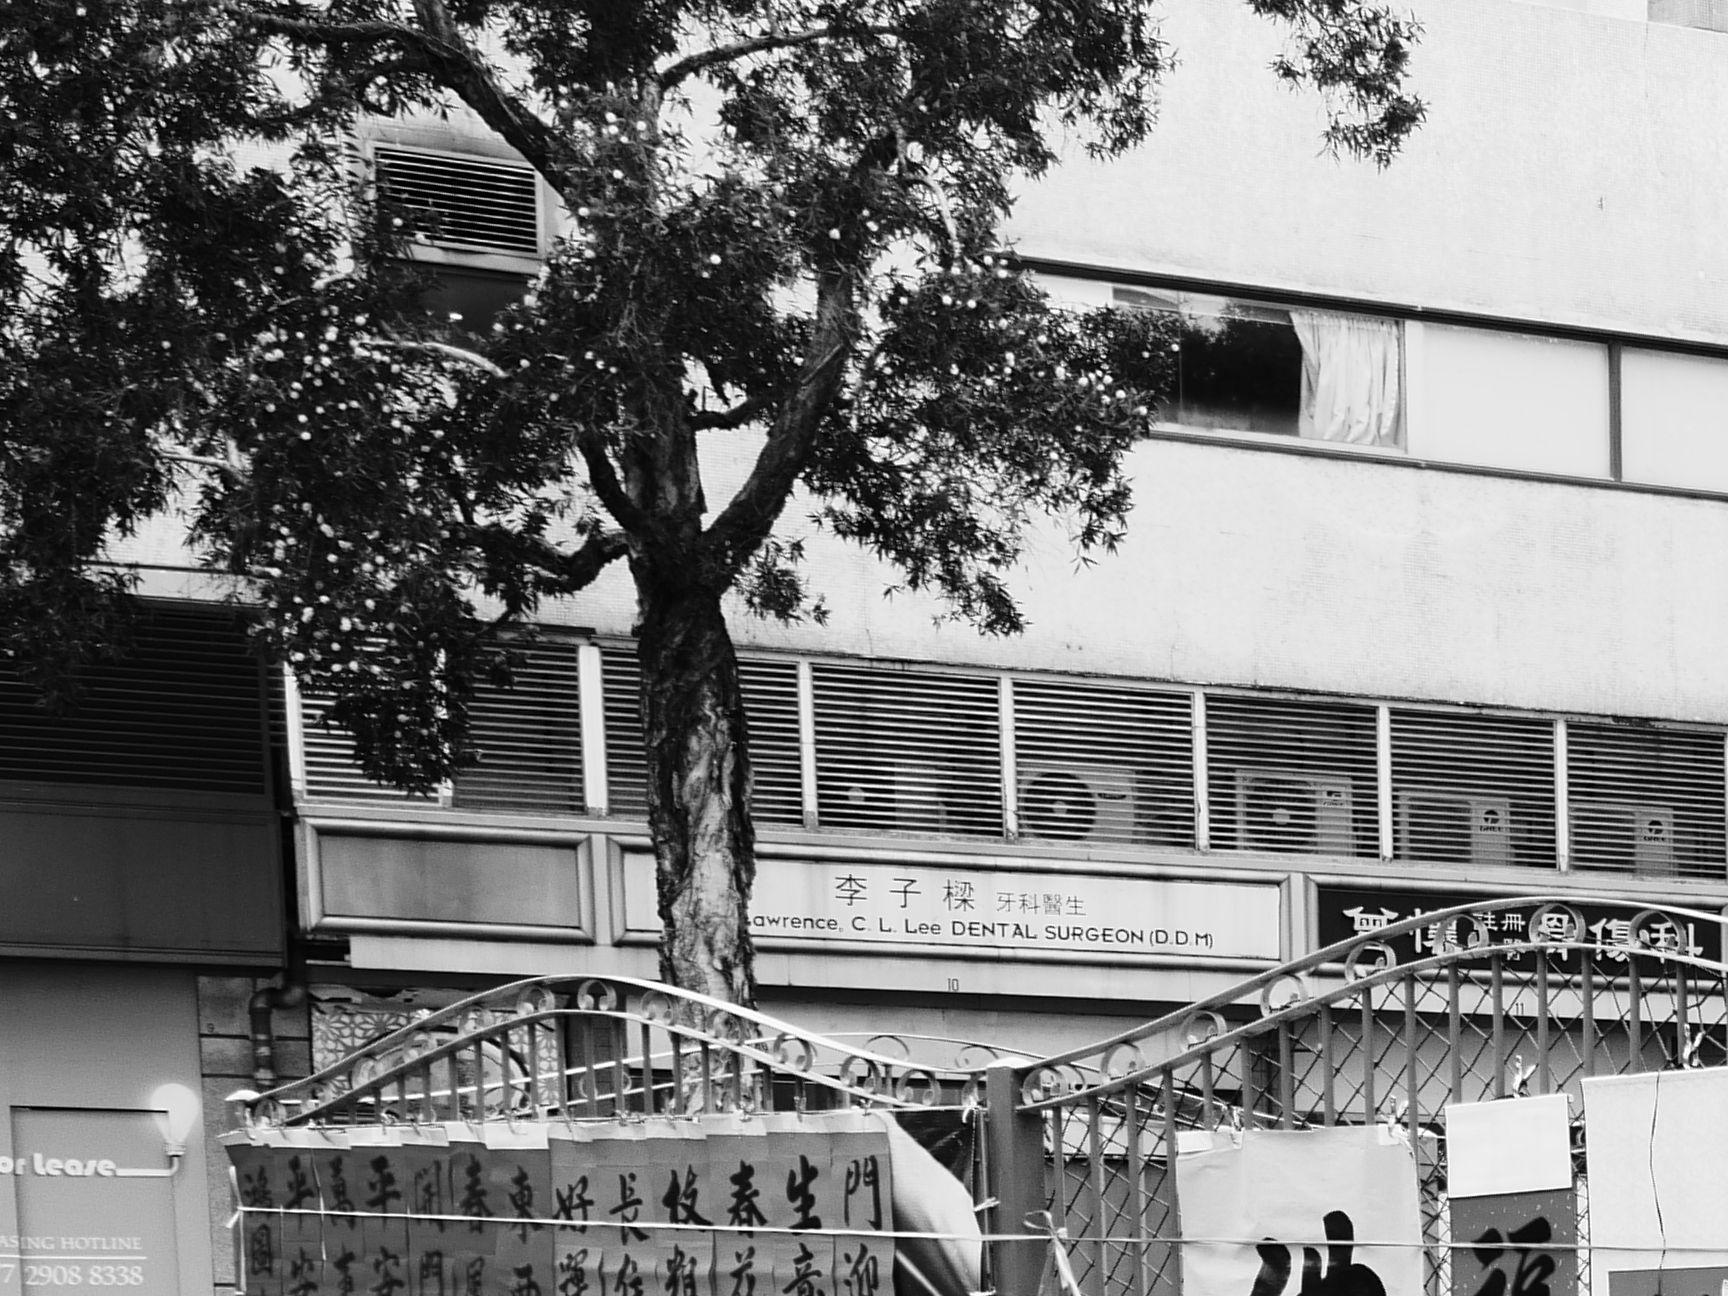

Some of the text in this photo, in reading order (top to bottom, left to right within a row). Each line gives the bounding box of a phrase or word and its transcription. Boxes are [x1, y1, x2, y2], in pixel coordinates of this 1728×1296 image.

[835, 874, 1087, 916] 李子樑 牙科醫生
[905, 918, 942, 935] Lee
[952, 920, 1037, 940] DENTAL
[1045, 925, 1144, 944] SURGEON
[948, 978, 959, 992] 10
[60, 1236, 143, 1251] HOTLINE
[25, 1265, 82, 1286] 2908
[89, 1265, 144, 1286] 8338
